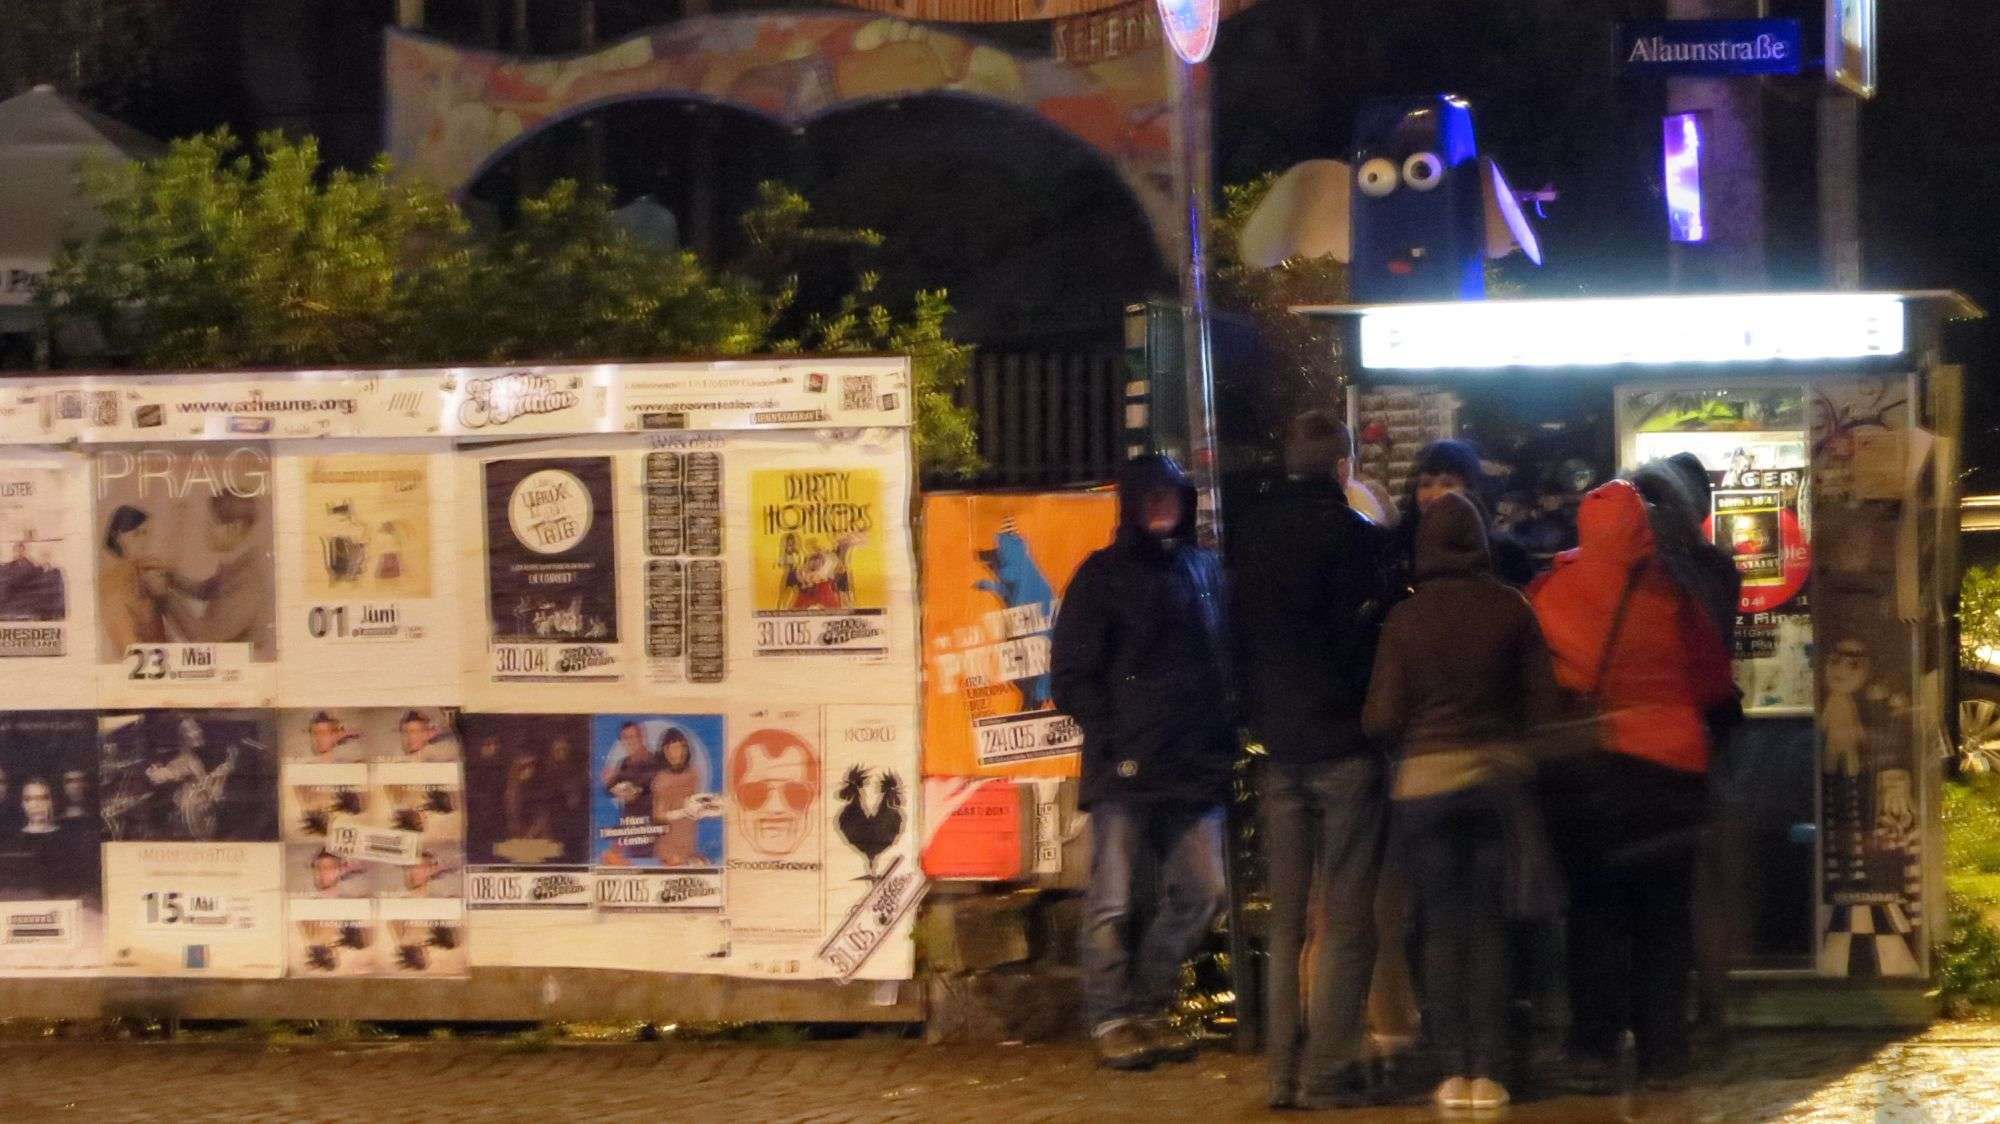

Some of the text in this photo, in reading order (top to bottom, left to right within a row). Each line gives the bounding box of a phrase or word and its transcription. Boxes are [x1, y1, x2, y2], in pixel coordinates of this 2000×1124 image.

[1628, 34, 1786, 62] Alaunstraße
[98, 447, 270, 498] PRAG
[785, 472, 850, 501] DIRTY
[763, 502, 873, 535] HONKERS
[182, 647, 216, 666] Mai
